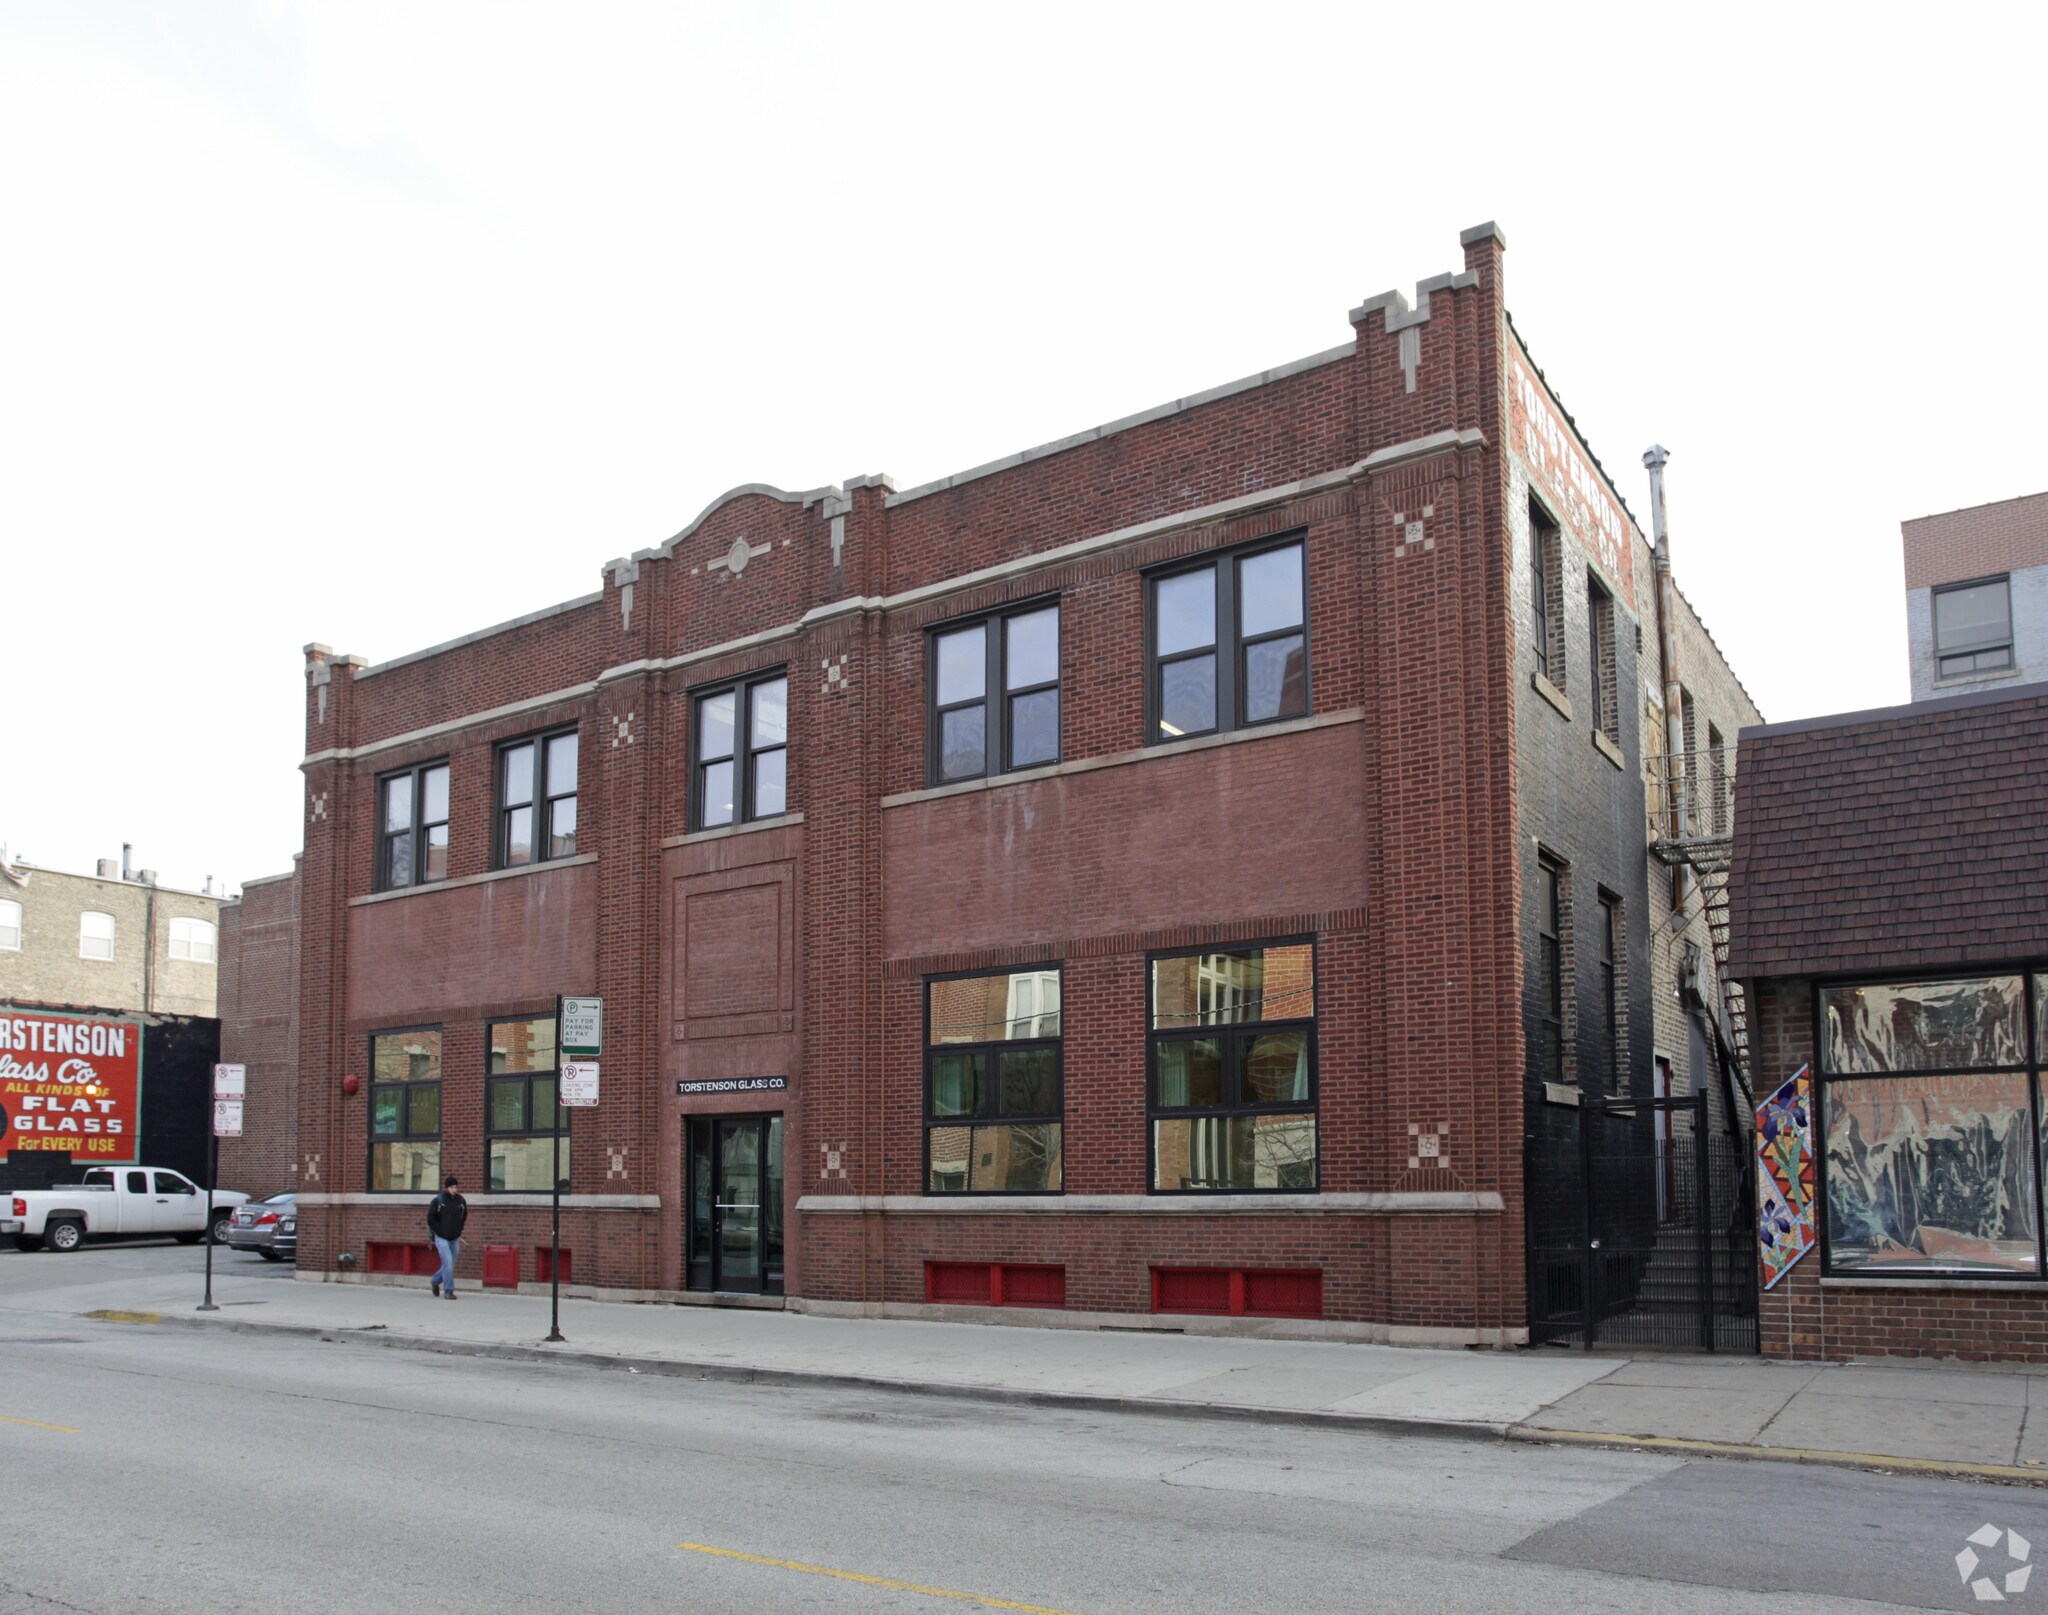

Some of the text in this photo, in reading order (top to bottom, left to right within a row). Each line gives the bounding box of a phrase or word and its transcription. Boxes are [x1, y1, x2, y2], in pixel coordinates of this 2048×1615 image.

[1514, 360, 1623, 549] TORSTENSON
[0, 1018, 125, 1058] RSTENSON
[56, 1058, 103, 1086] Co.
[5, 1082, 31, 1093] ALL
[35, 1084, 82, 1097] KINDS
[679, 1078, 785, 1093] TORSTENSON GLASS CO.
[22, 1096, 117, 1114] FLAT
[13, 1115, 123, 1134] GLASS
[17, 1136, 116, 1152] For EVERY USE
